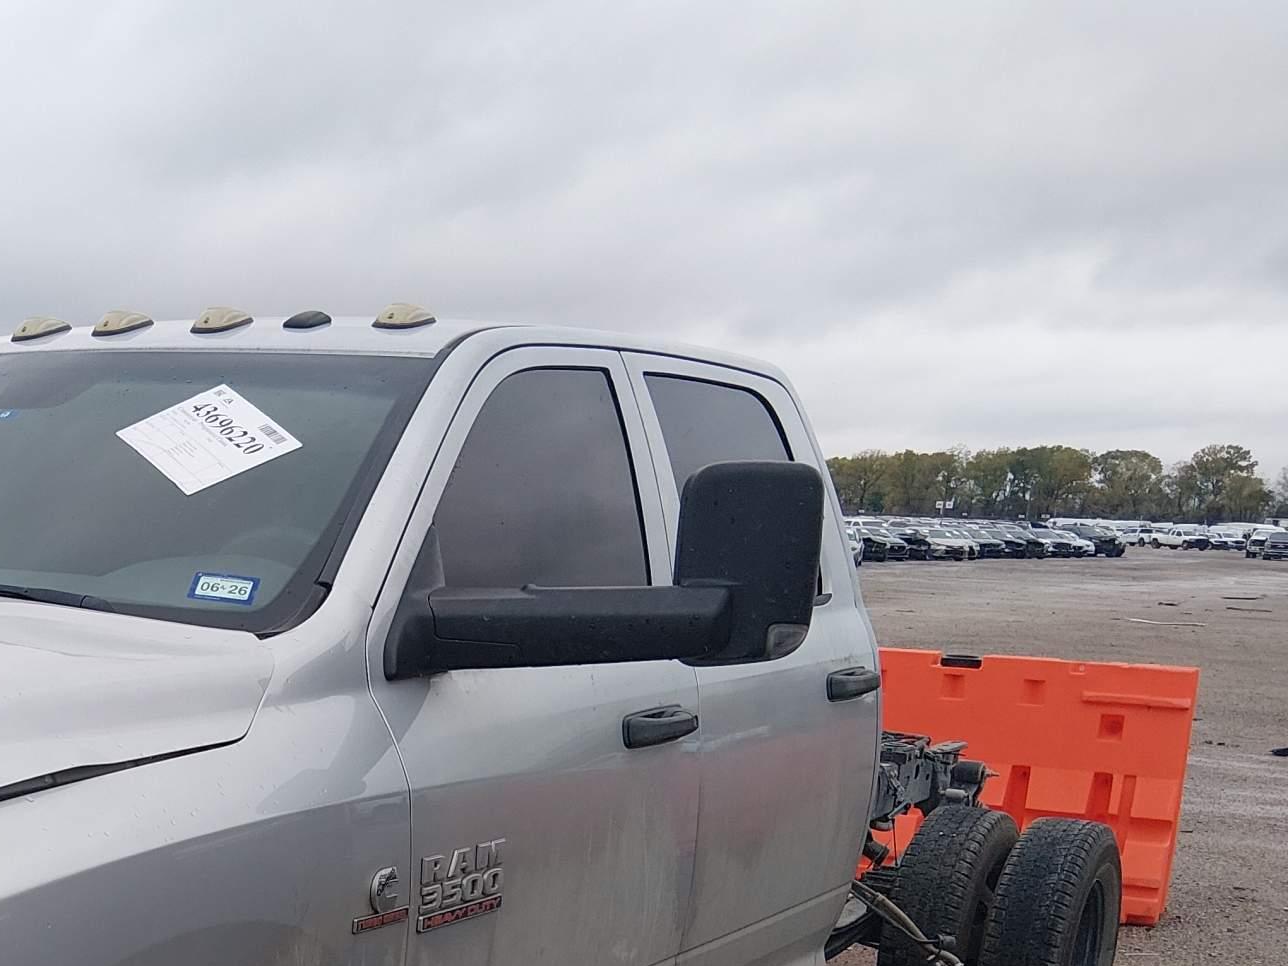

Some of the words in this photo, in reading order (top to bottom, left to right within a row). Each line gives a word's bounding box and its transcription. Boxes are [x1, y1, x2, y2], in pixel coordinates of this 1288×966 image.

[191, 402, 265, 455] 43696220
[199, 581, 221, 593] 06
[227, 584, 249, 596] 26
[421, 837, 507, 884] RAM
[419, 867, 505, 914] 3500
[424, 907, 467, 929] HEAVY
[467, 897, 501, 915] DUTY
